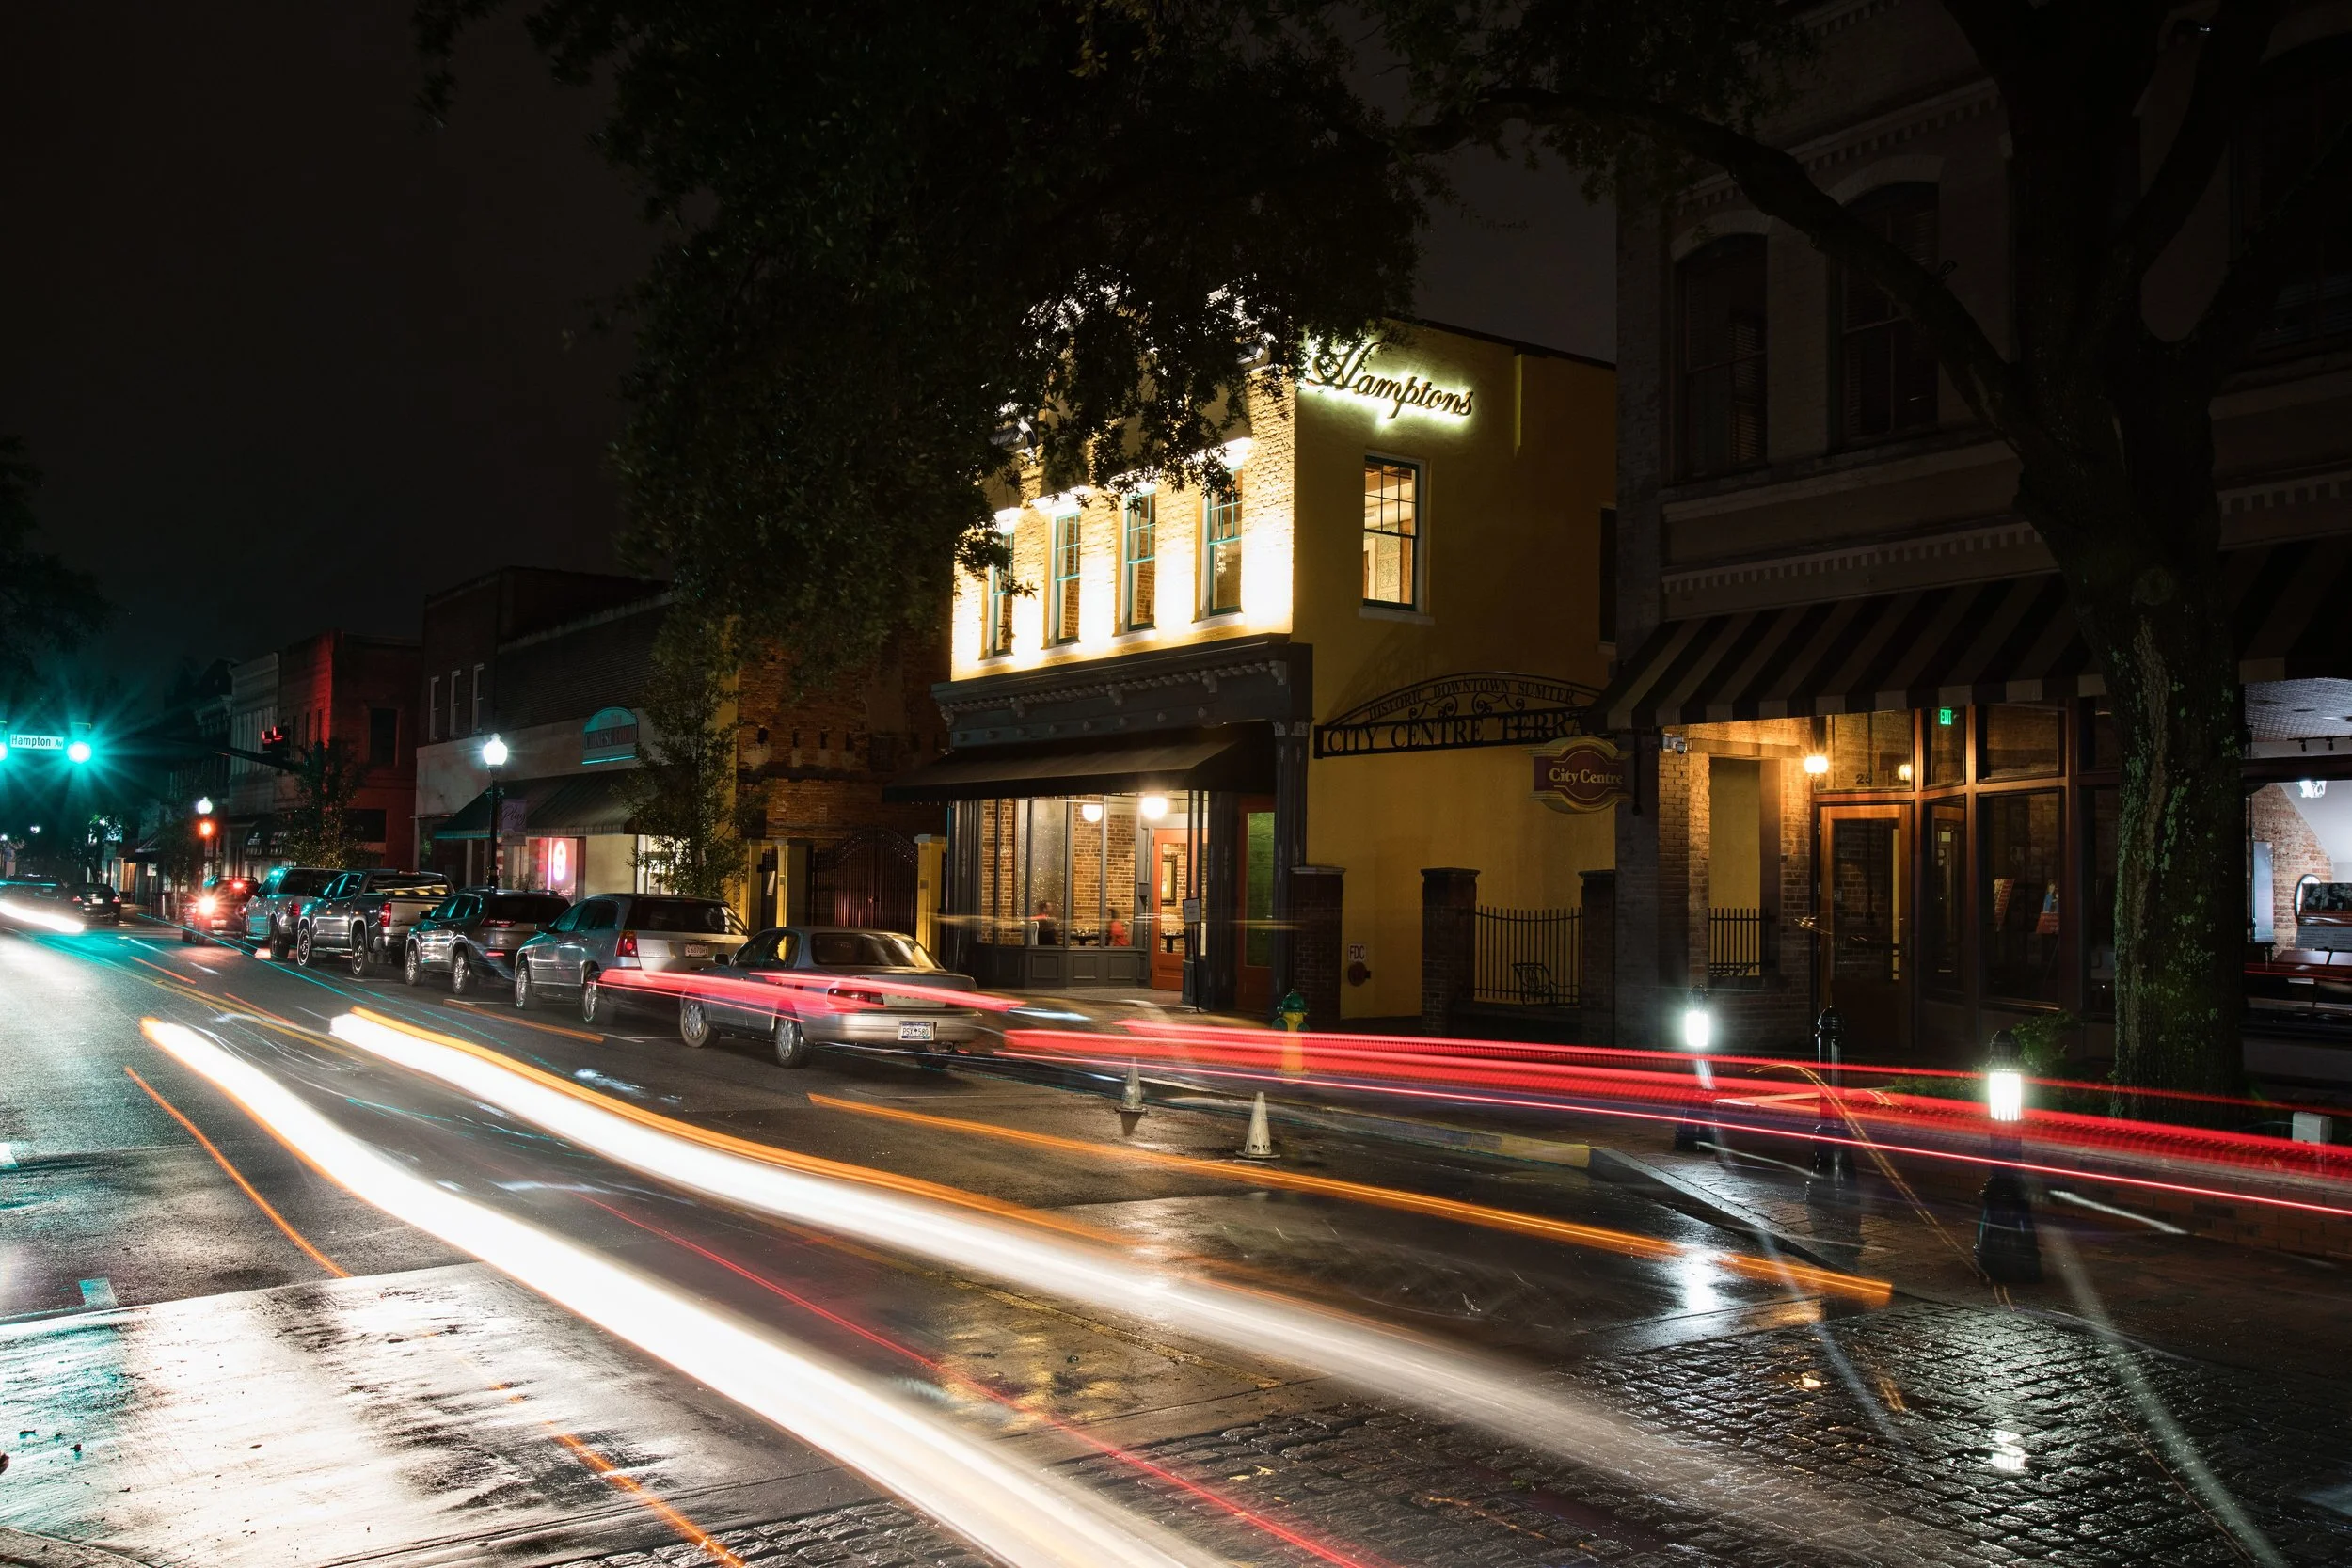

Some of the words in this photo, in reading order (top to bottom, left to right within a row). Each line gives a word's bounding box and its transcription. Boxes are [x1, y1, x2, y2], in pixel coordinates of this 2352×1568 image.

[1306, 341, 1475, 419] Hamptons
[1368, 689, 1424, 721] HISTORIC
[1433, 678, 1510, 700] DOWNTOWN
[1518, 681, 1576, 705] SUMTER
[1940, 708, 1952, 725] EXIT
[11, 735, 51, 748] Hampton
[55, 739, 63, 748] Av
[1327, 725, 1381, 753] CITY
[1391, 718, 1485, 749] CENTRE
[1498, 712, 1584, 740] TERRA
[1549, 768, 1579, 785] City
[1580, 768, 1624, 786] Centre
[1349, 945, 1365, 960] FDC
